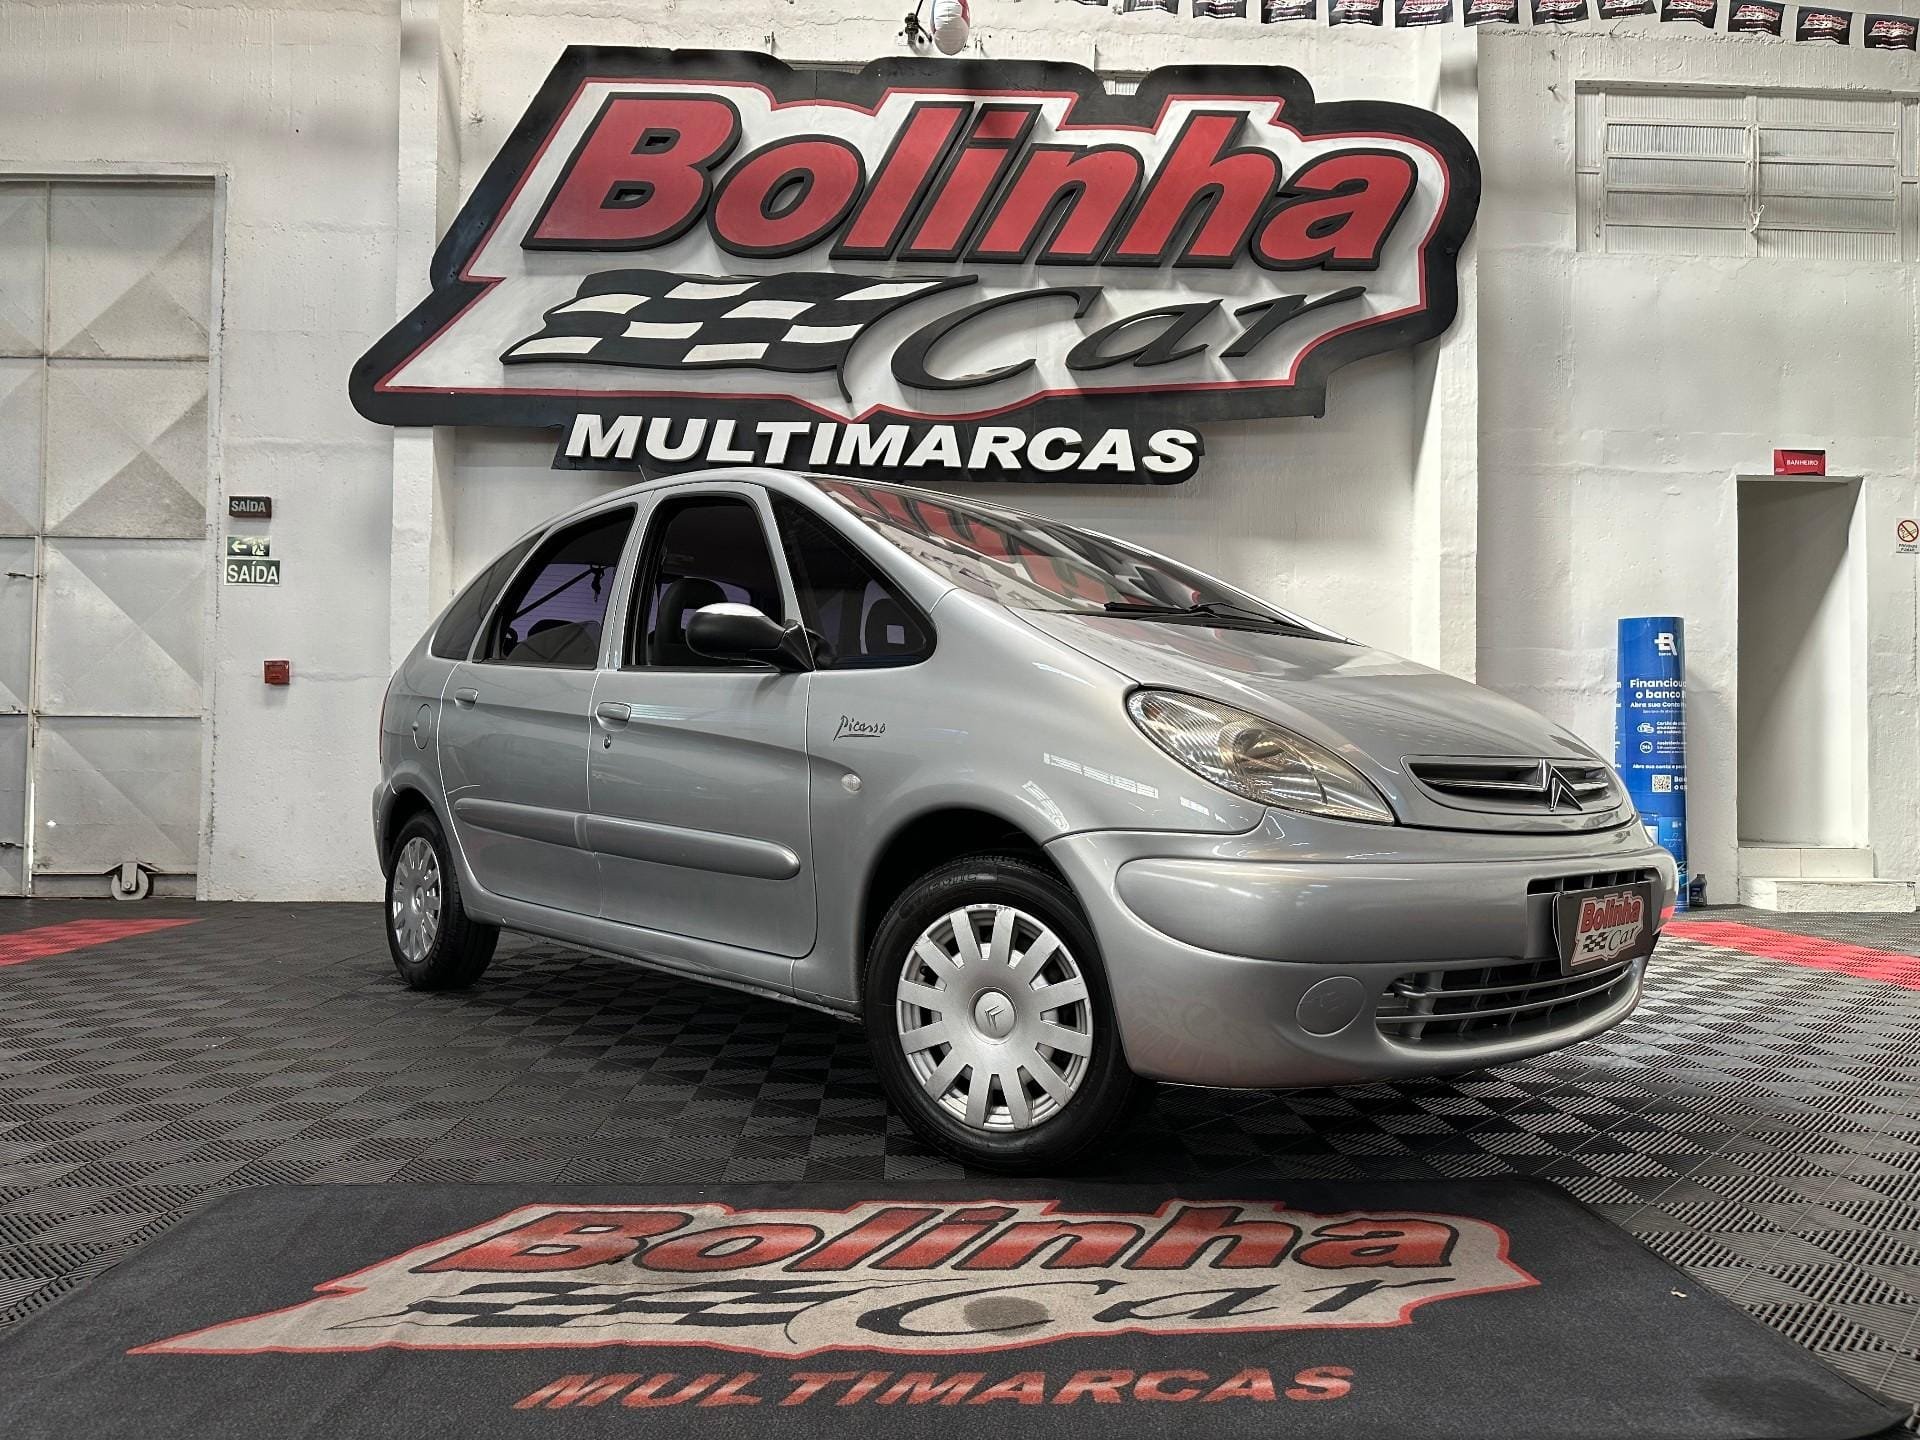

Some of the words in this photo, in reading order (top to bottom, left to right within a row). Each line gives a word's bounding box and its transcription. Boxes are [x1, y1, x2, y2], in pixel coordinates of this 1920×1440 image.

[520, 92, 1419, 270] Bolinha
[890, 285, 1368, 391] Car
[564, 413, 1198, 474] MULTIMARCAS
[231, 499, 266, 513] SAÍDA
[227, 560, 279, 584] SAÍDA
[1635, 691, 1644, 699] o
[1645, 689, 1681, 699] banco
[832, 714, 886, 742] Picasso
[1580, 896, 1641, 933] Bolinha
[1608, 925, 1639, 951] Car
[408, 1206, 1459, 1273] Bolinha
[855, 1276, 1457, 1336] Car
[513, 1365, 1354, 1409] MULTIMARCAS
